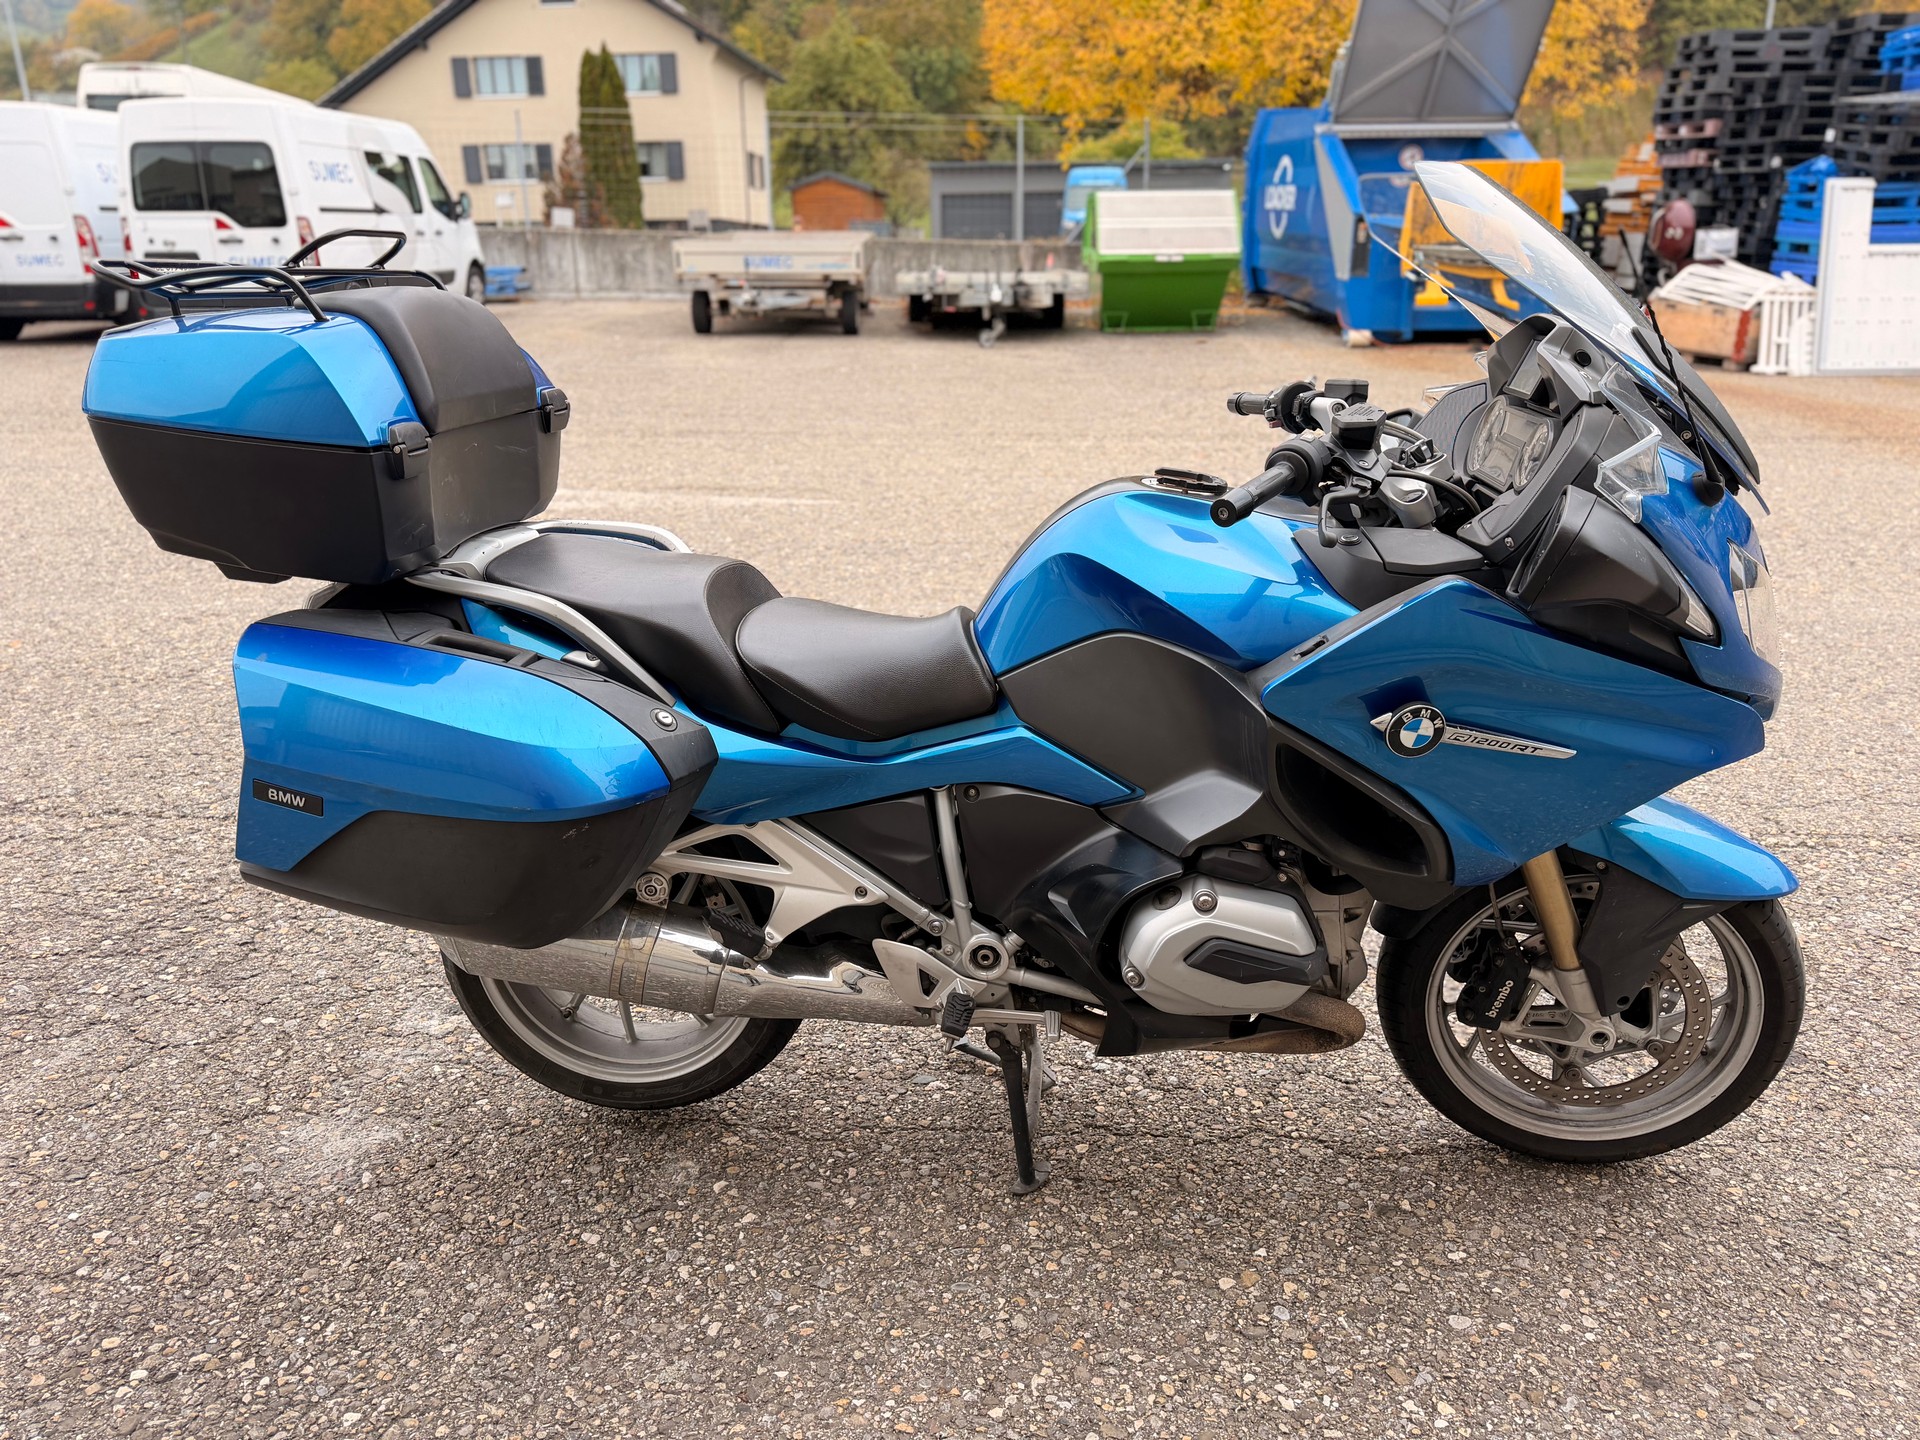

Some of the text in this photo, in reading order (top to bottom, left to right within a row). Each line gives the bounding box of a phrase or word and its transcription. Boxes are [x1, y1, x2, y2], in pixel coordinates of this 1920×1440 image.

[308, 160, 353, 183] SUMEC
[16, 254, 64, 267] SUMEC
[1403, 709, 1443, 728] BMW
[268, 788, 306, 807] BMW
[1485, 980, 1514, 1019] brembo
